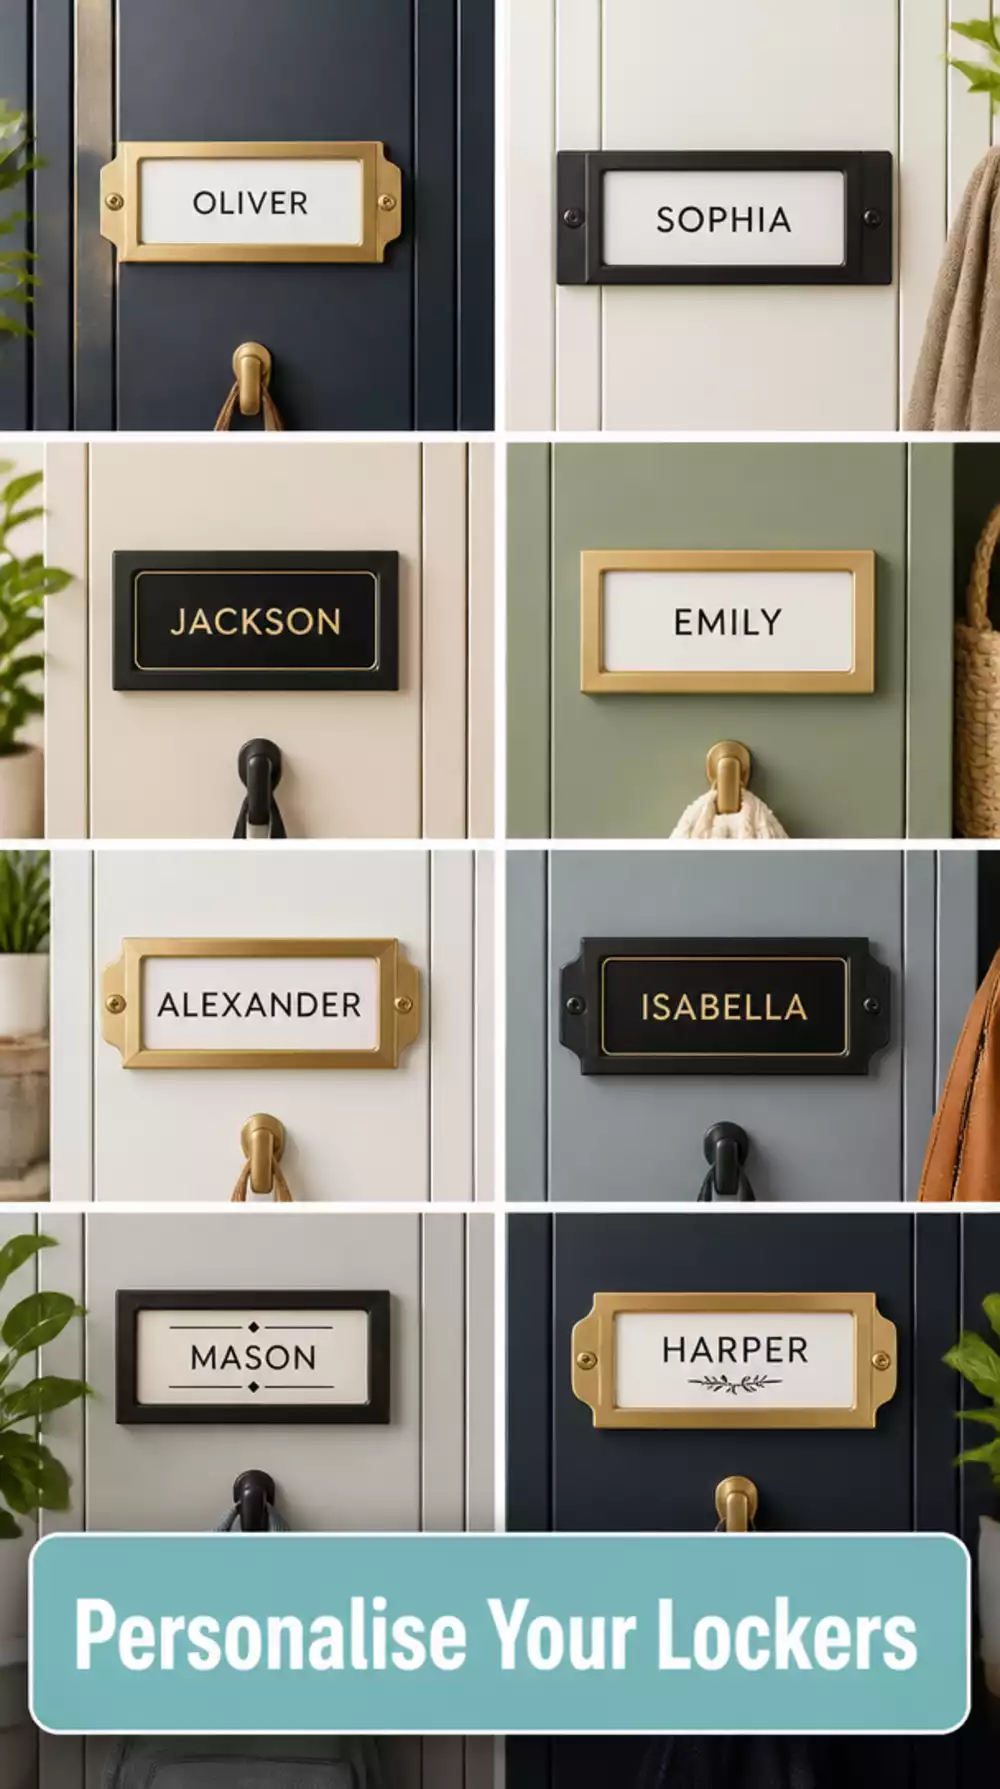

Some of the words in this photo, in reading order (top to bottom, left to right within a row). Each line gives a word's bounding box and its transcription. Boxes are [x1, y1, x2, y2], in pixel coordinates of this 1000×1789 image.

[193, 190, 308, 215] OLIVER
[656, 205, 792, 233] SOPHIA
[170, 607, 341, 636] JACKSON
[675, 608, 782, 636] EMILY
[157, 991, 361, 1018] ALEXANDER
[642, 993, 808, 1021] ISABELLA
[191, 1344, 315, 1371] MASON
[663, 1336, 808, 1364] HARPER
